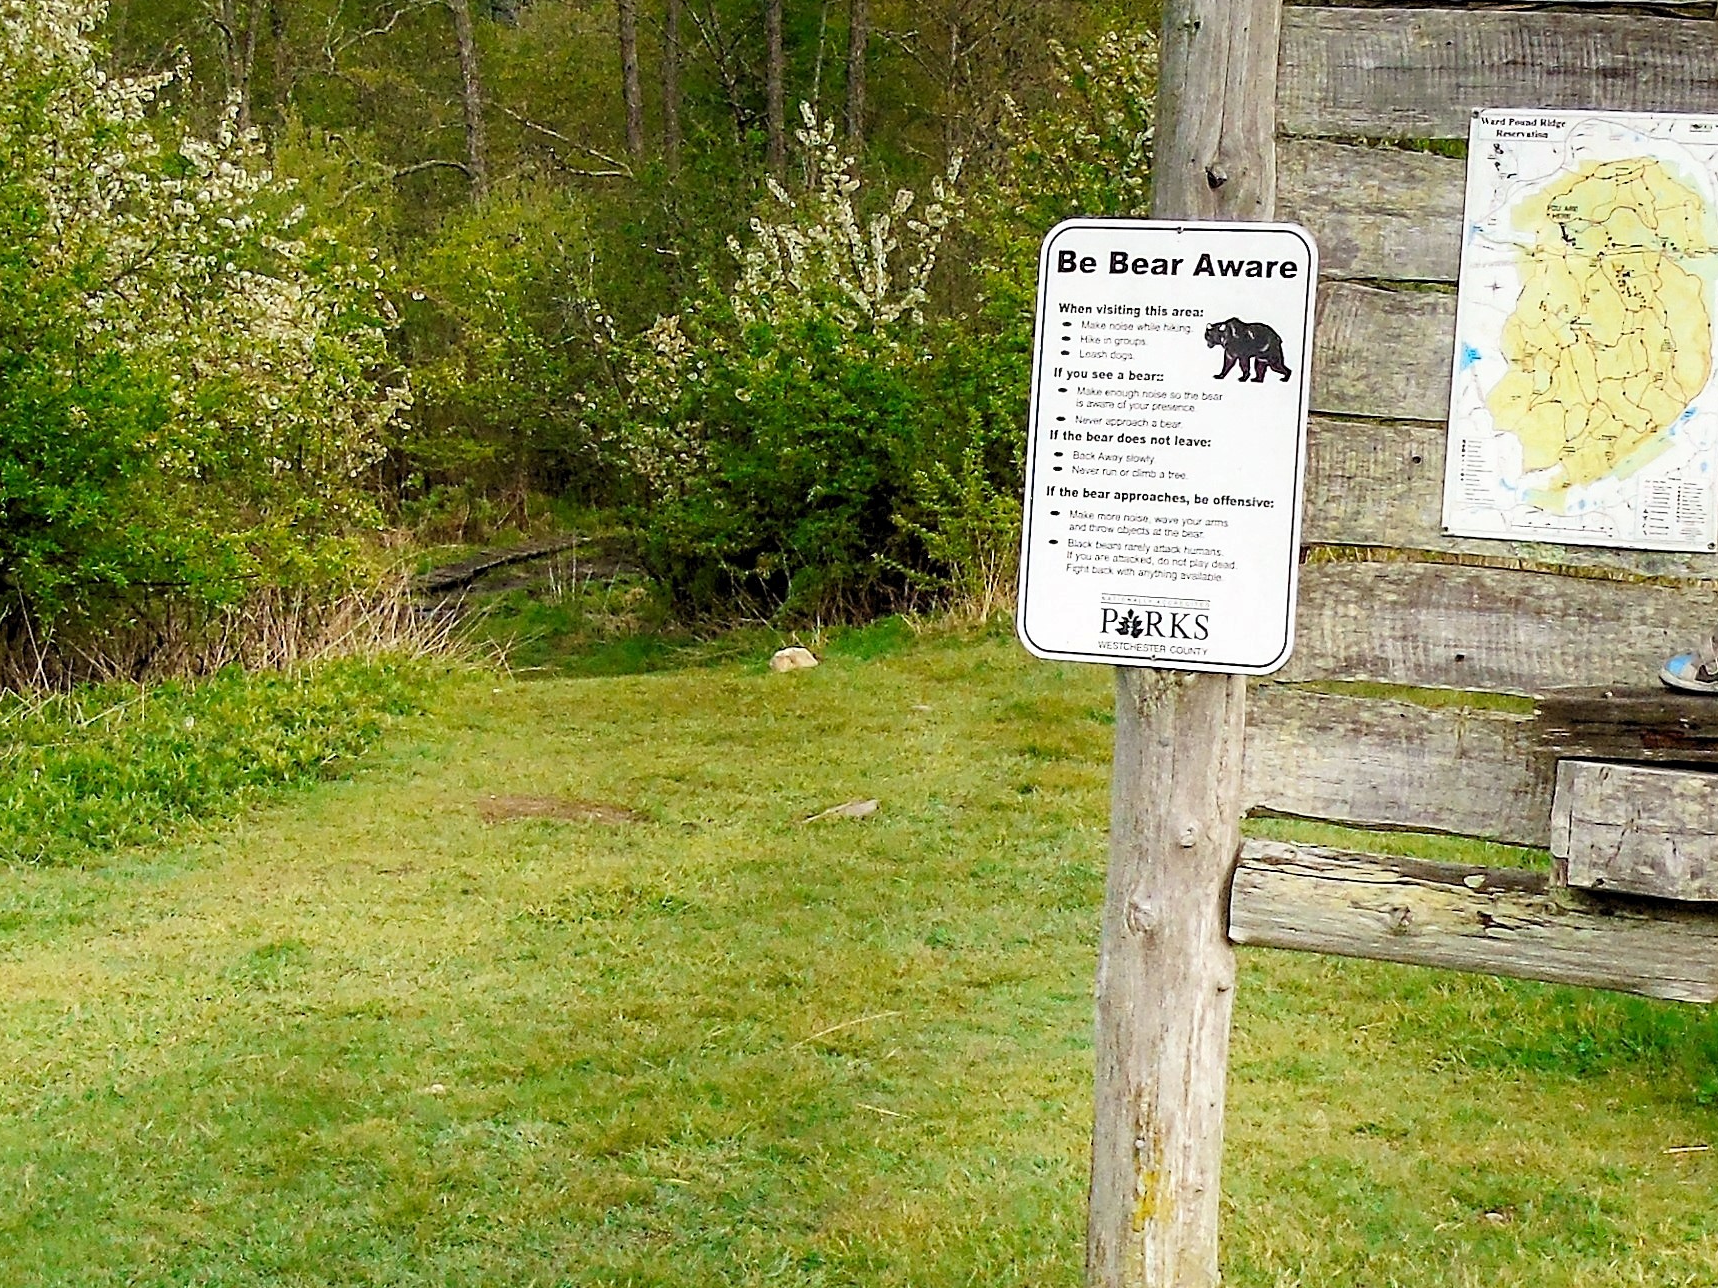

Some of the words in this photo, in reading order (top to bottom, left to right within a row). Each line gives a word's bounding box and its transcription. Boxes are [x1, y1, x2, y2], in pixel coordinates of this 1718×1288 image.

[1509, 118, 1538, 127] Pound
[1540, 119, 1566, 129] Ridge
[1057, 250, 1097, 274] Be
[1109, 251, 1184, 276] Bear
[1193, 253, 1298, 279] Aware
[1059, 303, 1092, 314] When
[1096, 305, 1140, 317] visiting
[1145, 306, 1168, 316] this
[1172, 308, 1204, 317] area:
[1082, 321, 1105, 329] Make
[1110, 322, 1133, 330] noise
[1138, 323, 1160, 331] while
[1080, 335, 1100, 344] Hike
[1079, 349, 1107, 358] Leash
[1054, 368, 1062, 377] If
[1067, 370, 1087, 380] you
[1092, 371, 1113, 379] see
[1077, 387, 1102, 395] Make
[1105, 388, 1139, 399] enough
[1142, 390, 1167, 398] noise
[1170, 391, 1181, 399] so
[1184, 392, 1198, 400] the
[1202, 392, 1223, 401] bear
[1129, 402, 1149, 411] your
[1075, 415, 1102, 424] Never
[1105, 416, 1148, 427] approach
[1050, 430, 1058, 440] If
[1063, 431, 1081, 441] the
[1086, 432, 1113, 442] bear
[1117, 434, 1146, 444] does
[1151, 435, 1170, 445] not
[1175, 436, 1211, 447] leave:
[1073, 451, 1095, 460] Back
[1098, 452, 1123, 463] Away
[1072, 465, 1099, 475] Never
[1102, 468, 1117, 476] run
[1120, 468, 1129, 476] or
[1047, 486, 1055, 496] If
[1060, 486, 1078, 497] the
[1083, 487, 1110, 499] bear
[1114, 490, 1190, 505] approaches,
[1195, 494, 1209, 504] be
[1213, 495, 1275, 508] offensive:
[1069, 510, 1094, 520] Make
[1098, 512, 1120, 522] more
[1154, 516, 1178, 525] wave
[1182, 516, 1201, 526] your
[1069, 522, 1086, 532] and
[1089, 523, 1114, 533] throw
[1117, 525, 1150, 536] objects
[1164, 528, 1179, 537] the
[1068, 538, 1092, 549] Black
[1075, 552, 1092, 562] you
[1095, 553, 1109, 561] are
[1158, 556, 1169, 565] do
[1173, 557, 1187, 567] not
[1066, 563, 1089, 575] Fight
[1138, 568, 1177, 581] anything
[1100, 608, 1209, 640] PARKS
[1098, 641, 1165, 653] WESTCHESTER
[1170, 646, 1208, 655] COUNTY
